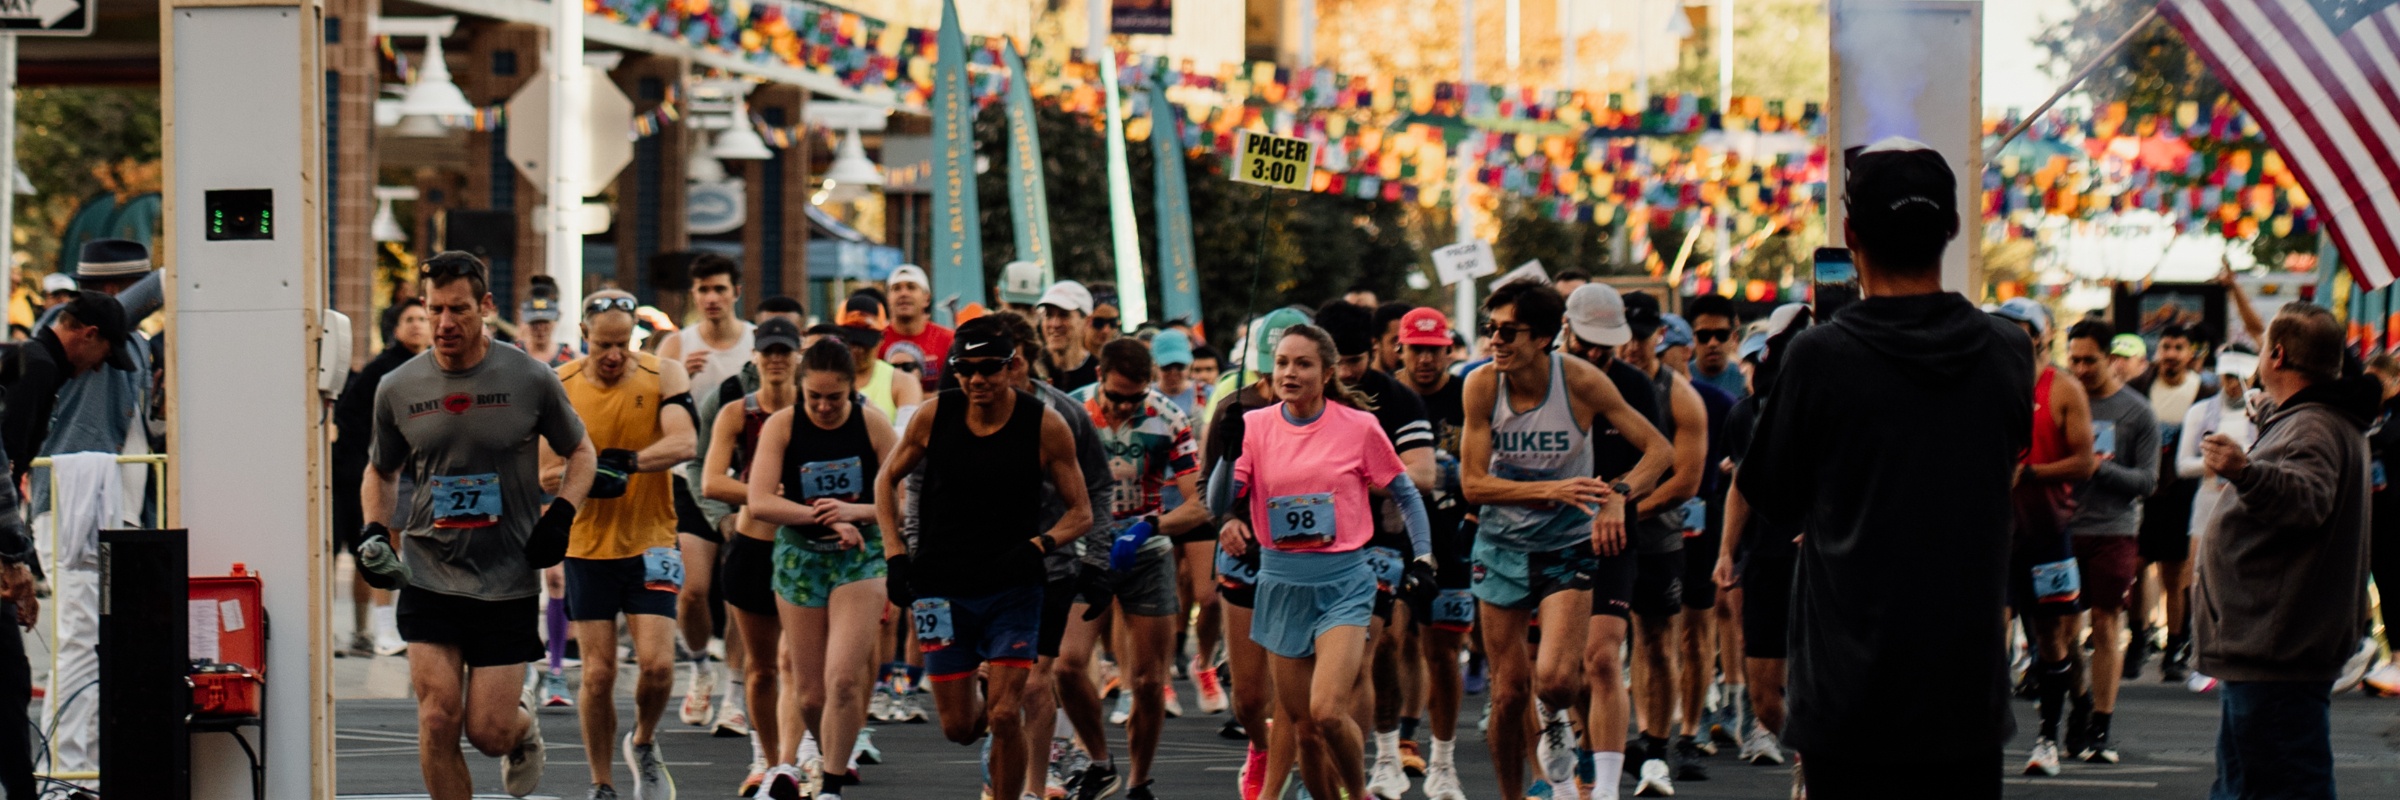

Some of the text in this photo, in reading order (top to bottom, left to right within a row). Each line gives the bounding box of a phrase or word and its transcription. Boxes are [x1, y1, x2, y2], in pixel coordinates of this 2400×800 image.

[1248, 133, 1308, 162] PACER
[1252, 158, 1296, 184] 3:00
[409, 393, 511, 414] ARMY ROTC
[815, 472, 850, 491] 136
[450, 490, 481, 510] 27
[1286, 510, 1316, 531] 98
[661, 560, 680, 579] 92
[1443, 601, 1471, 618] 167
[916, 613, 938, 634] 29
